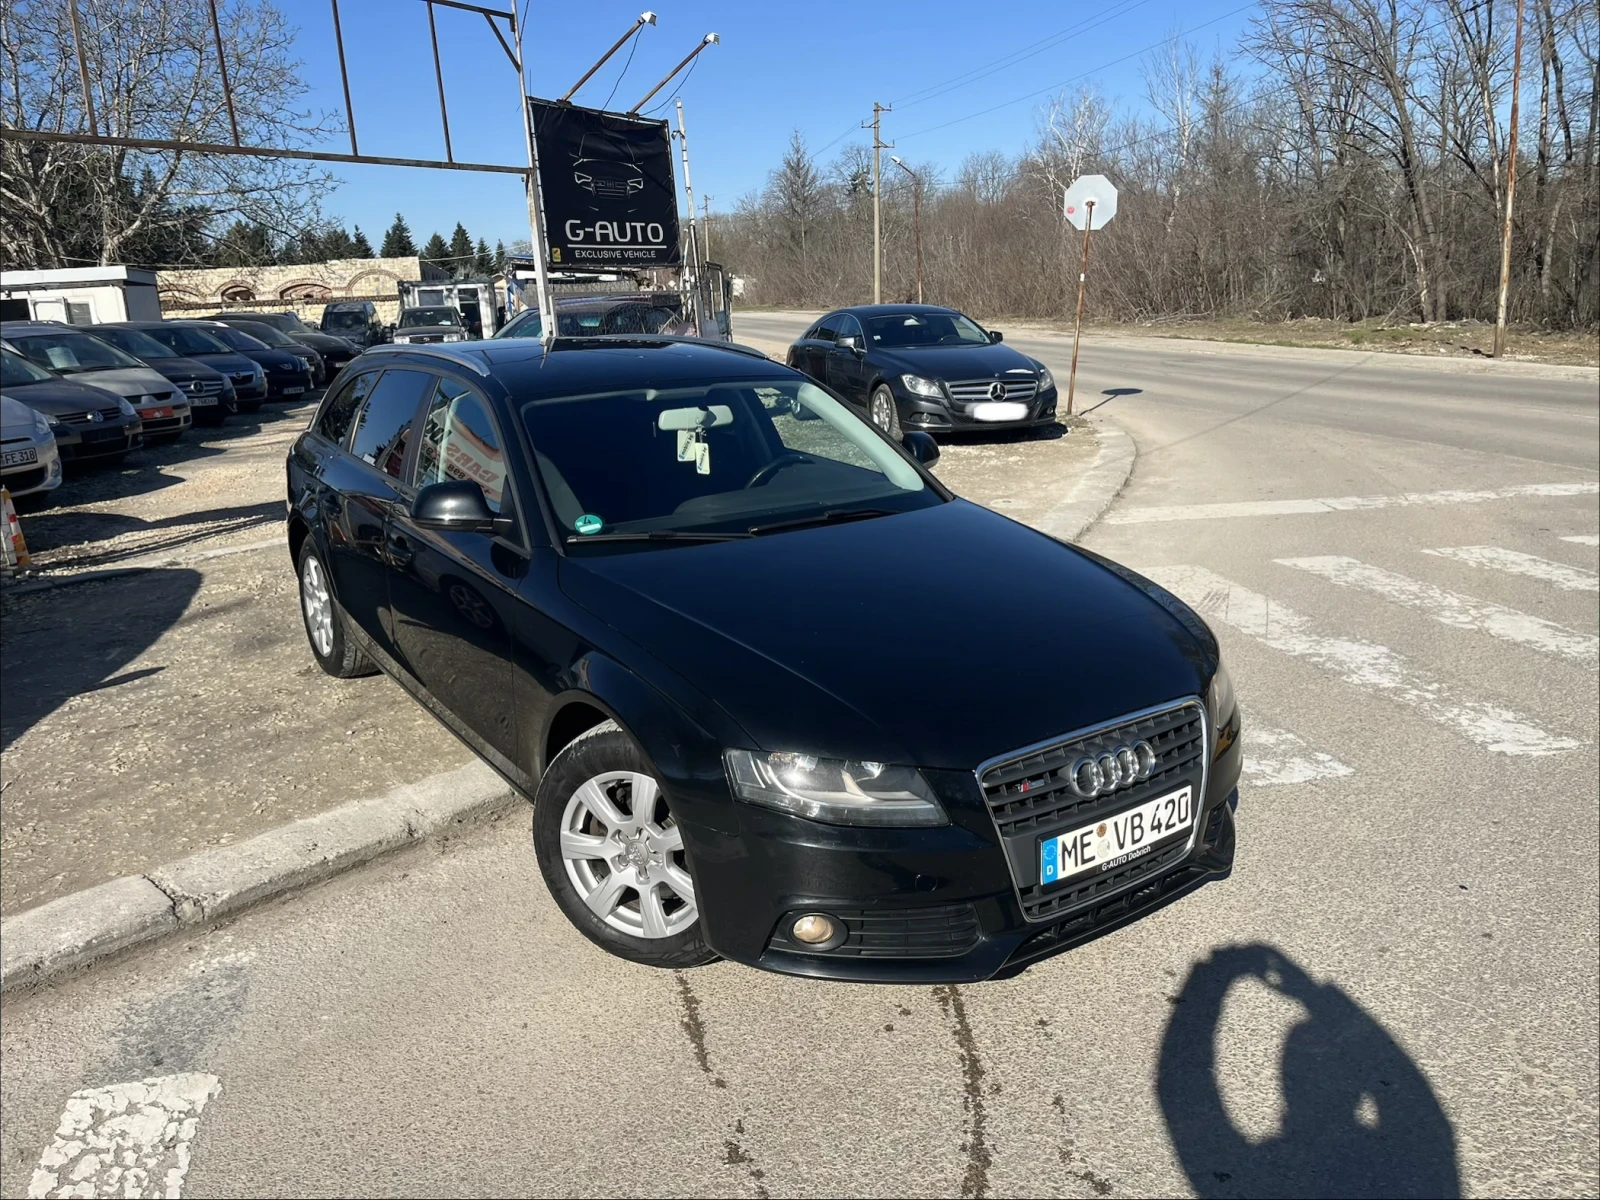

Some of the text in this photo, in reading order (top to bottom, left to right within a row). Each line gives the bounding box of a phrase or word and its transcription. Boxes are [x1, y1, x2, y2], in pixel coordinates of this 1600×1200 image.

[565, 219, 663, 243] G-AUTO
[575, 250, 656, 258] EXCLUSIVE VEHICLE
[5, 450, 35, 465] FE 318
[1062, 792, 1189, 871] ME VB 420
[1102, 845, 1151, 871] G-AUTO Dobrich
[1046, 864, 1054, 875] D
